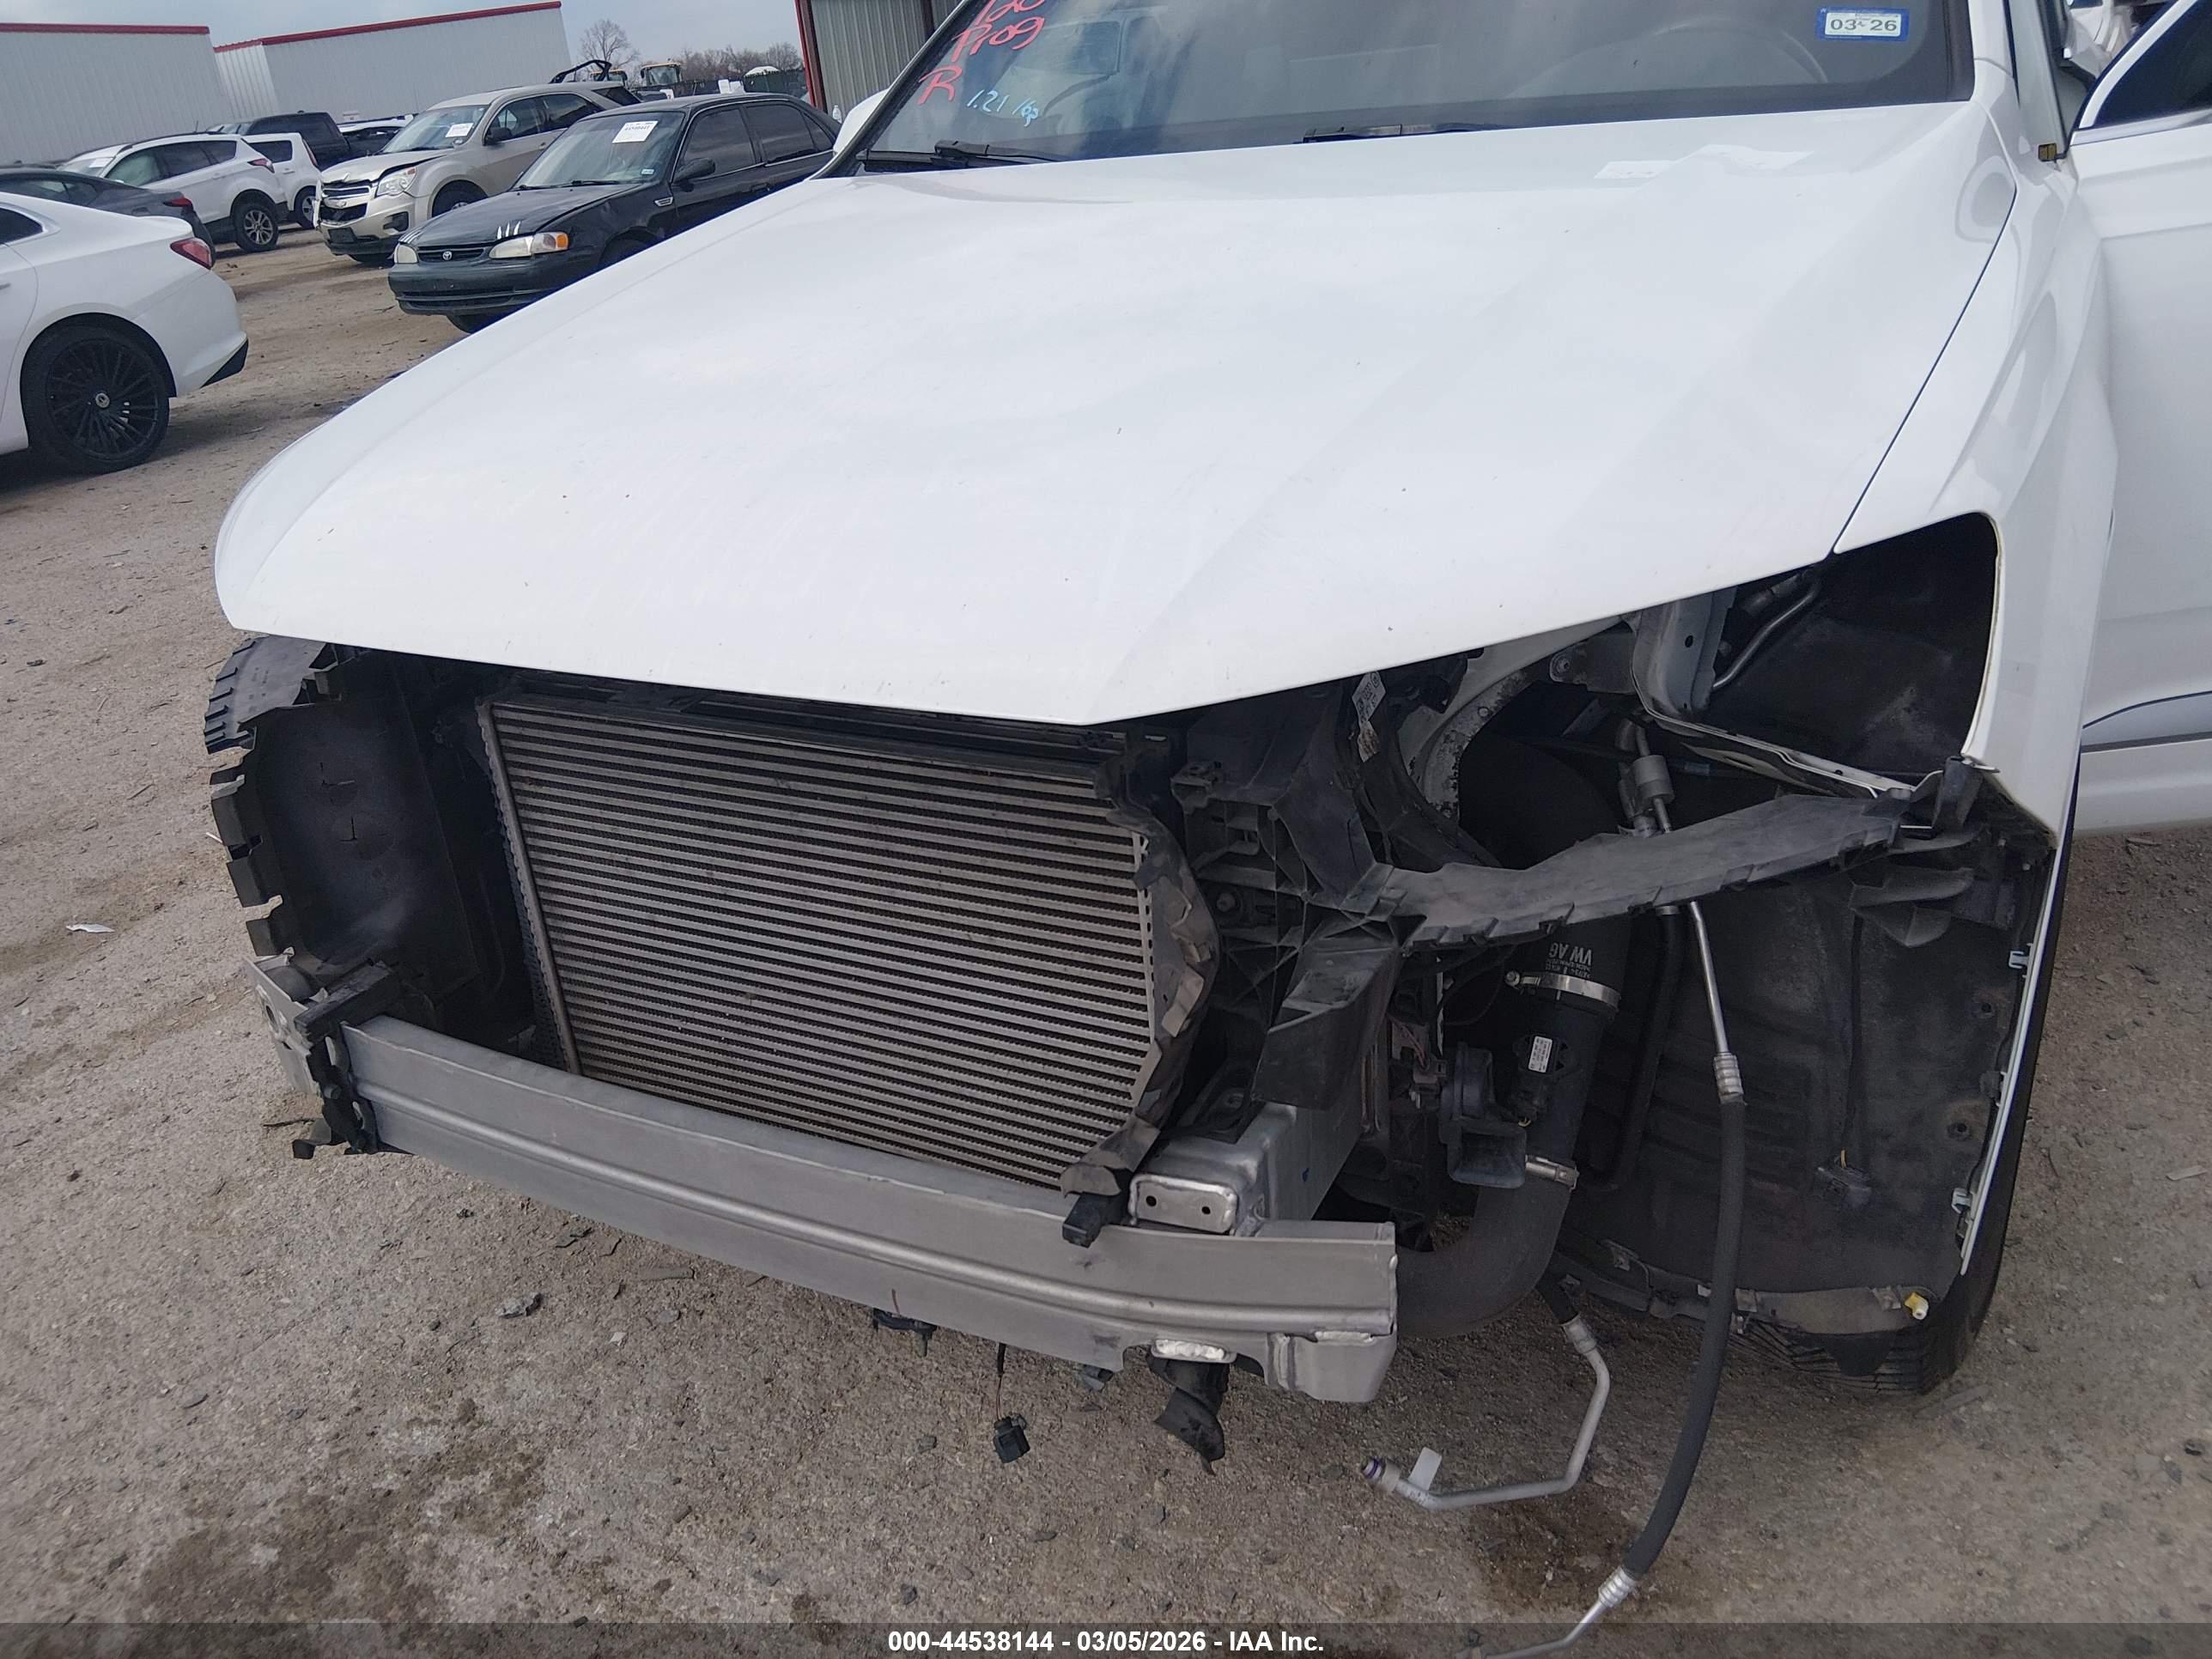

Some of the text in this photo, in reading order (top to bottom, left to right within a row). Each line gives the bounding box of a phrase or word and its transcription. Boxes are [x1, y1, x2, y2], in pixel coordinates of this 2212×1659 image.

[1830, 19, 1897, 31] 03 26
[916, 65, 963, 106] R
[1548, 942, 1592, 966] VW AG
